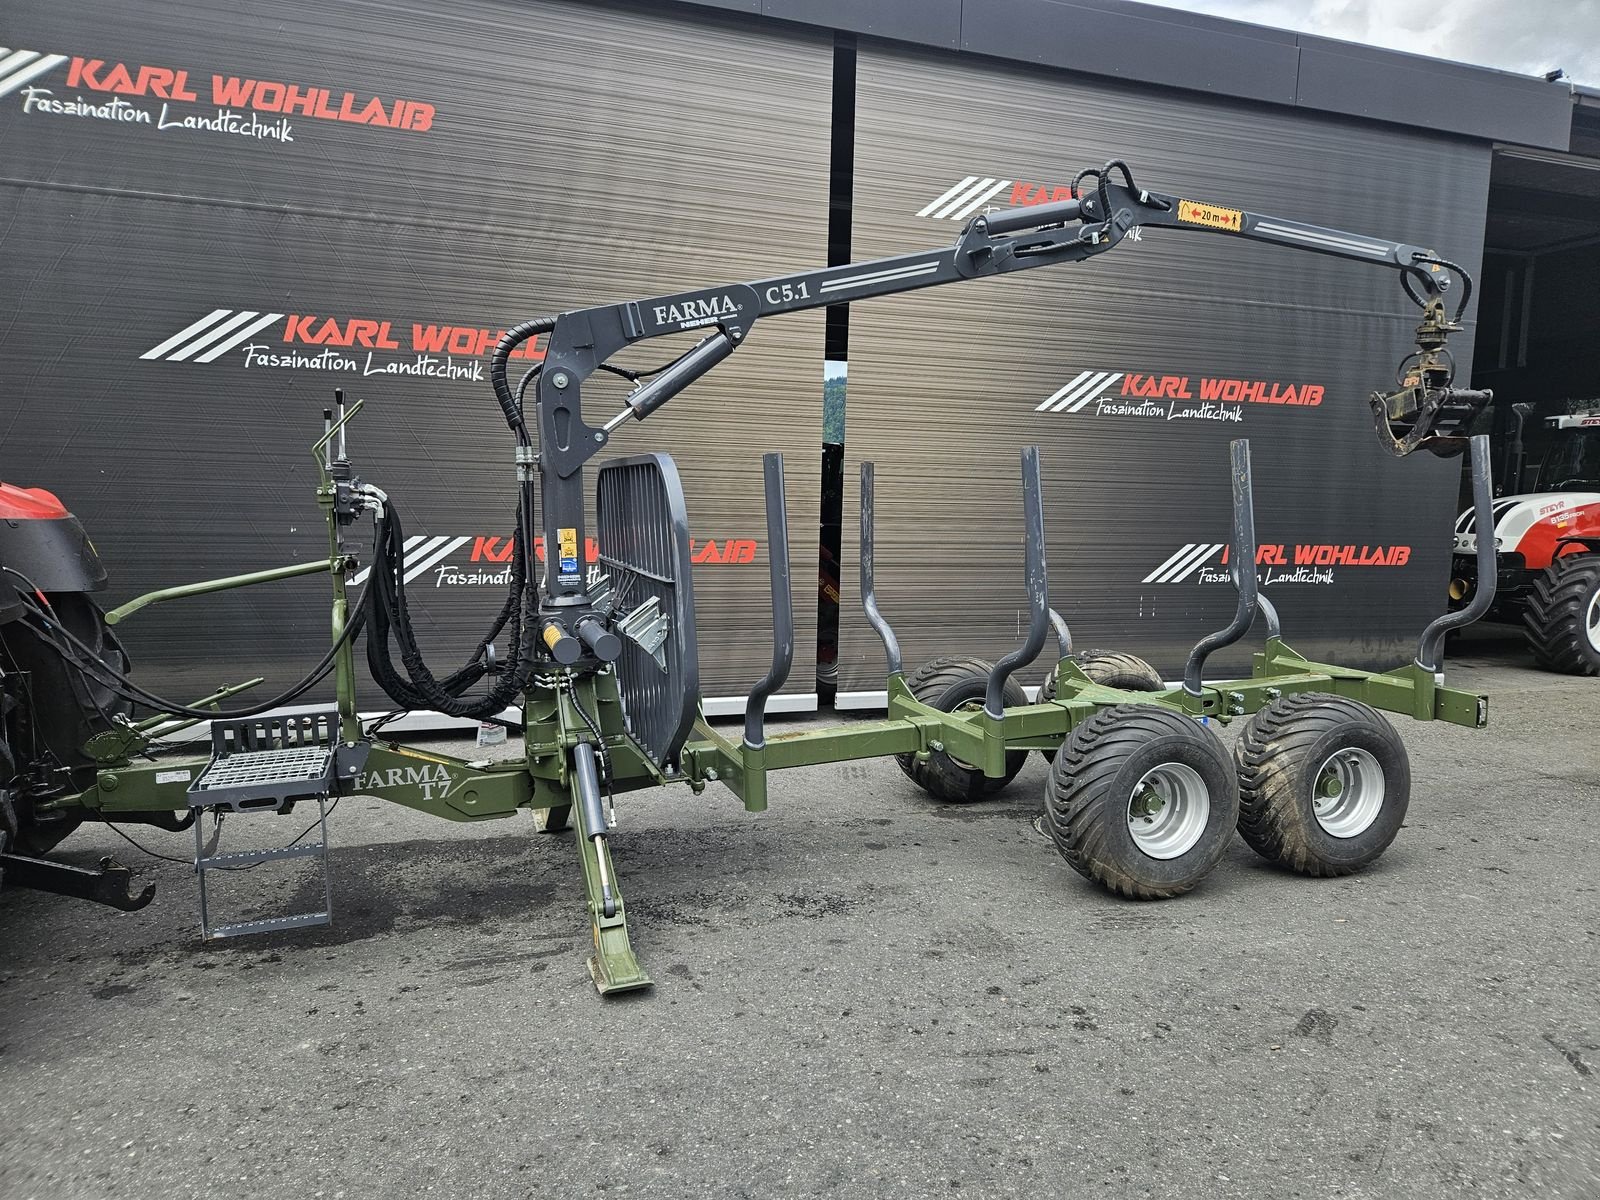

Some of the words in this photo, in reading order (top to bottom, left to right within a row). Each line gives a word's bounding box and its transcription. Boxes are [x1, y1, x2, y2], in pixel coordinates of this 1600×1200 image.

[66, 56, 197, 102] KARL
[21, 85, 151, 124] Faszination
[157, 102, 294, 142] Landtechnik
[1201, 209, 1212, 221] 20
[1212, 214, 1220, 223] m
[765, 281, 811, 304] C5.1
[283, 314, 399, 350] KARL
[243, 343, 357, 372] Faszination
[363, 350, 484, 382] Landtechnik
[1120, 373, 1193, 399] KARL
[1095, 396, 1164, 417] Faszination
[1167, 400, 1243, 423] Landtechnik
[1264, 566, 1334, 586] Landtechnik
[418, 779, 452, 801] T7
